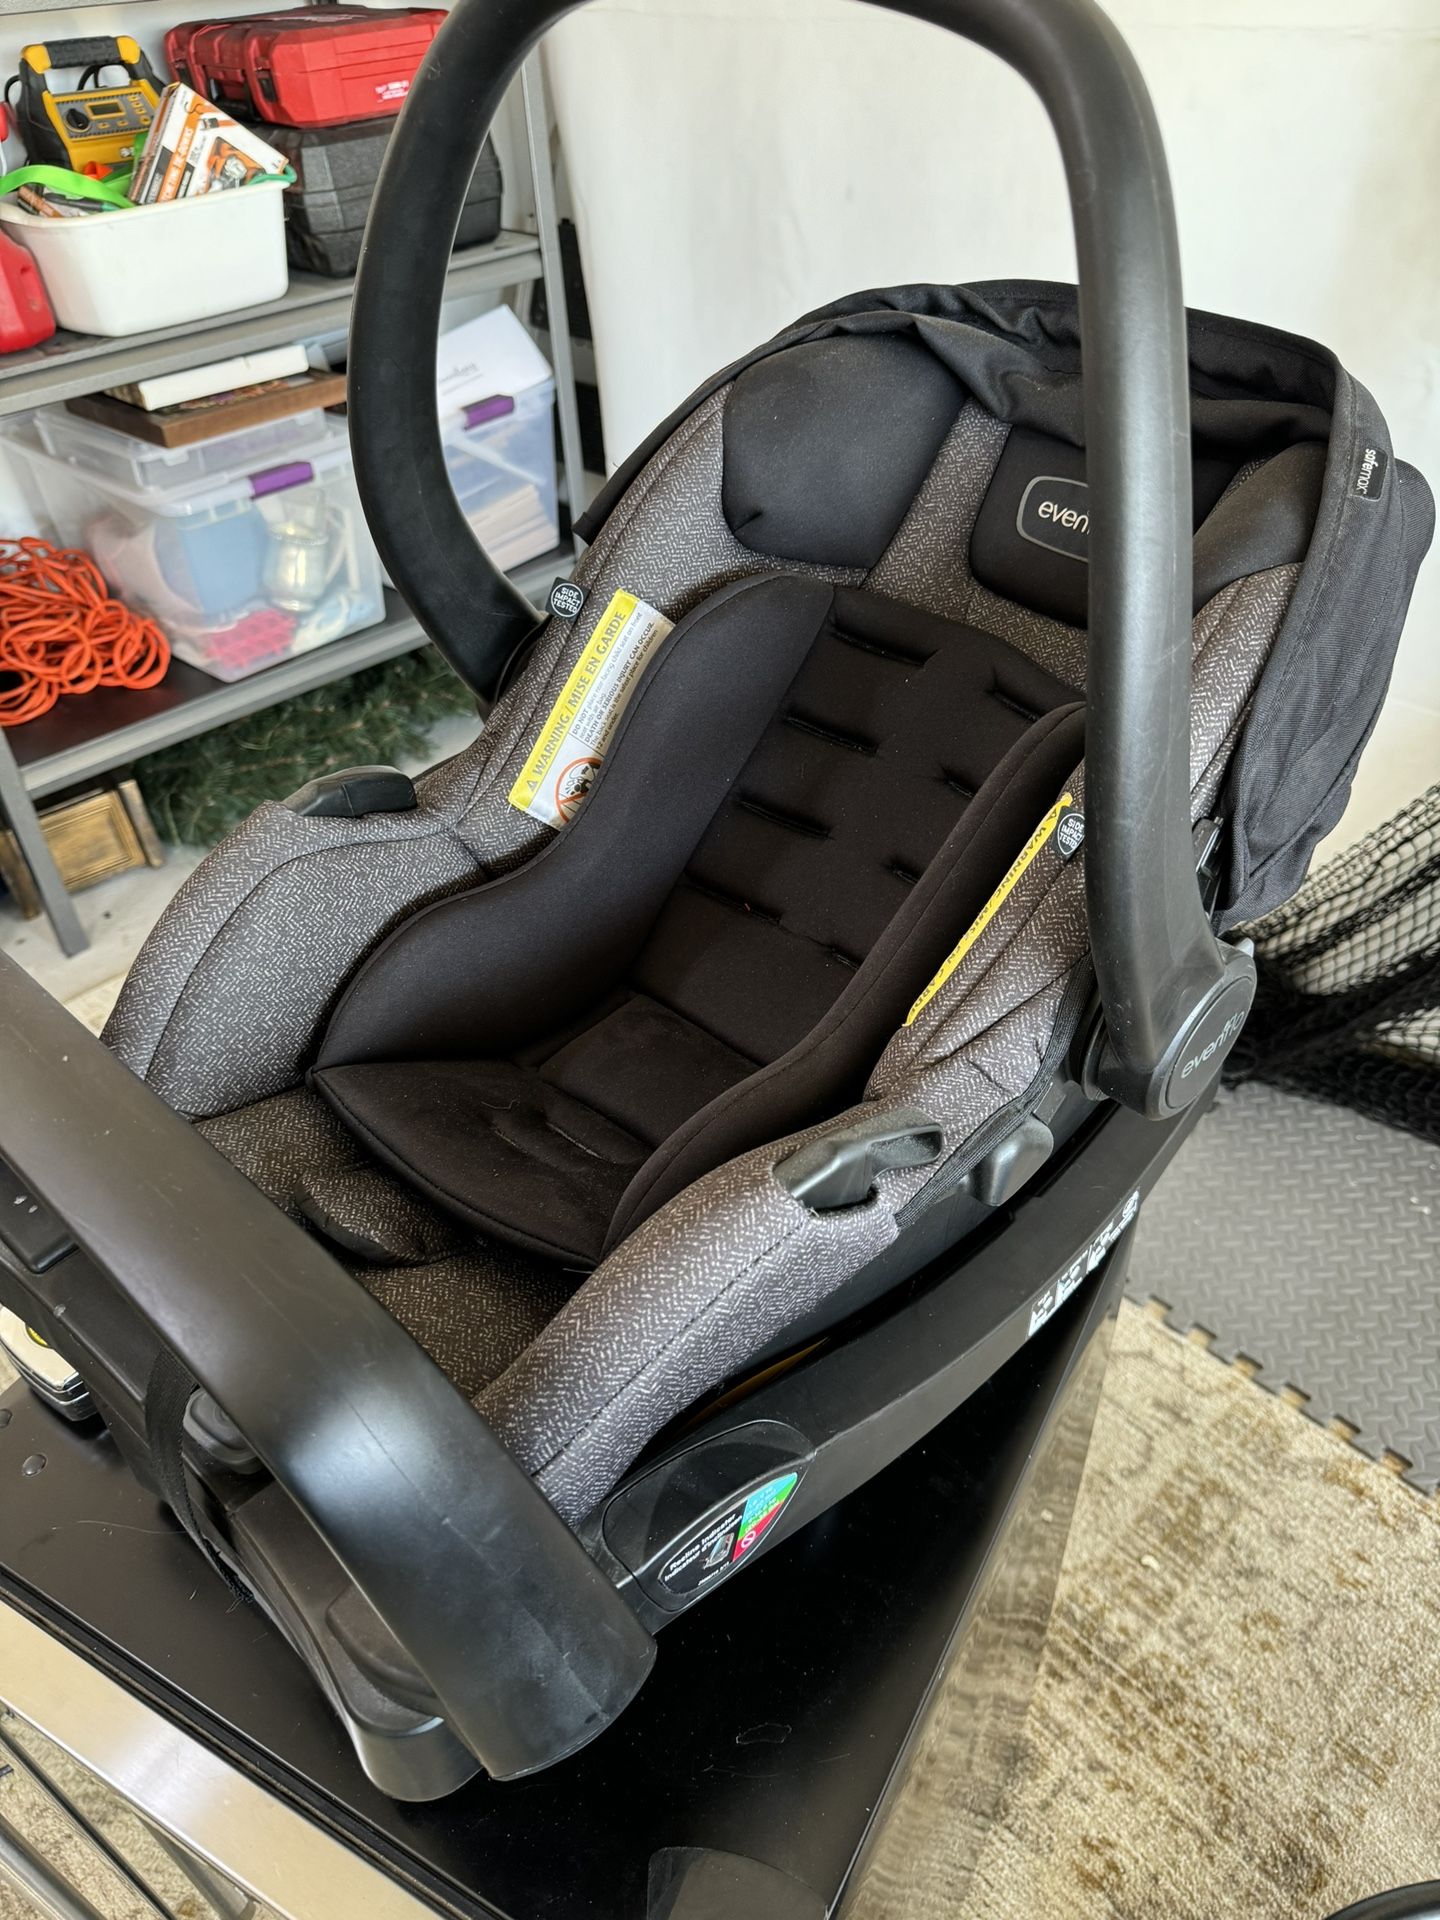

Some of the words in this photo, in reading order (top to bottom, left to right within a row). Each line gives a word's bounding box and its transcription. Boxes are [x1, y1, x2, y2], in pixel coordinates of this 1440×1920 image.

[1037, 500, 1090, 535] even
[553, 598, 578, 614] TESTED
[554, 591, 581, 607] IMPACT
[561, 587, 579, 599] SIDE
[532, 713, 570, 775] WARNING
[567, 675, 590, 707] MISE
[584, 656, 600, 675] EN
[596, 611, 626, 654] GARDE
[584, 720, 599, 742] DEATH
[596, 709, 604, 720] OR
[601, 683, 618, 709] SERIOUS
[616, 659, 631, 682] INJURY
[629, 644, 639, 659] CAN
[589, 735, 600, 746] The
[596, 722, 607, 735] back
[605, 709, 614, 721] seat
[613, 693, 622, 703] the
[619, 676, 631, 693] safest
[628, 661, 639, 678] place
[642, 629, 658, 652] children
[572, 724, 580, 735] DO
[578, 708, 588, 724] NOT
[601, 729, 609, 742] and
[1181, 1011, 1245, 1079] evenflo
[670, 1544, 700, 1571] Recline
[701, 1513, 736, 1546] Indicator
